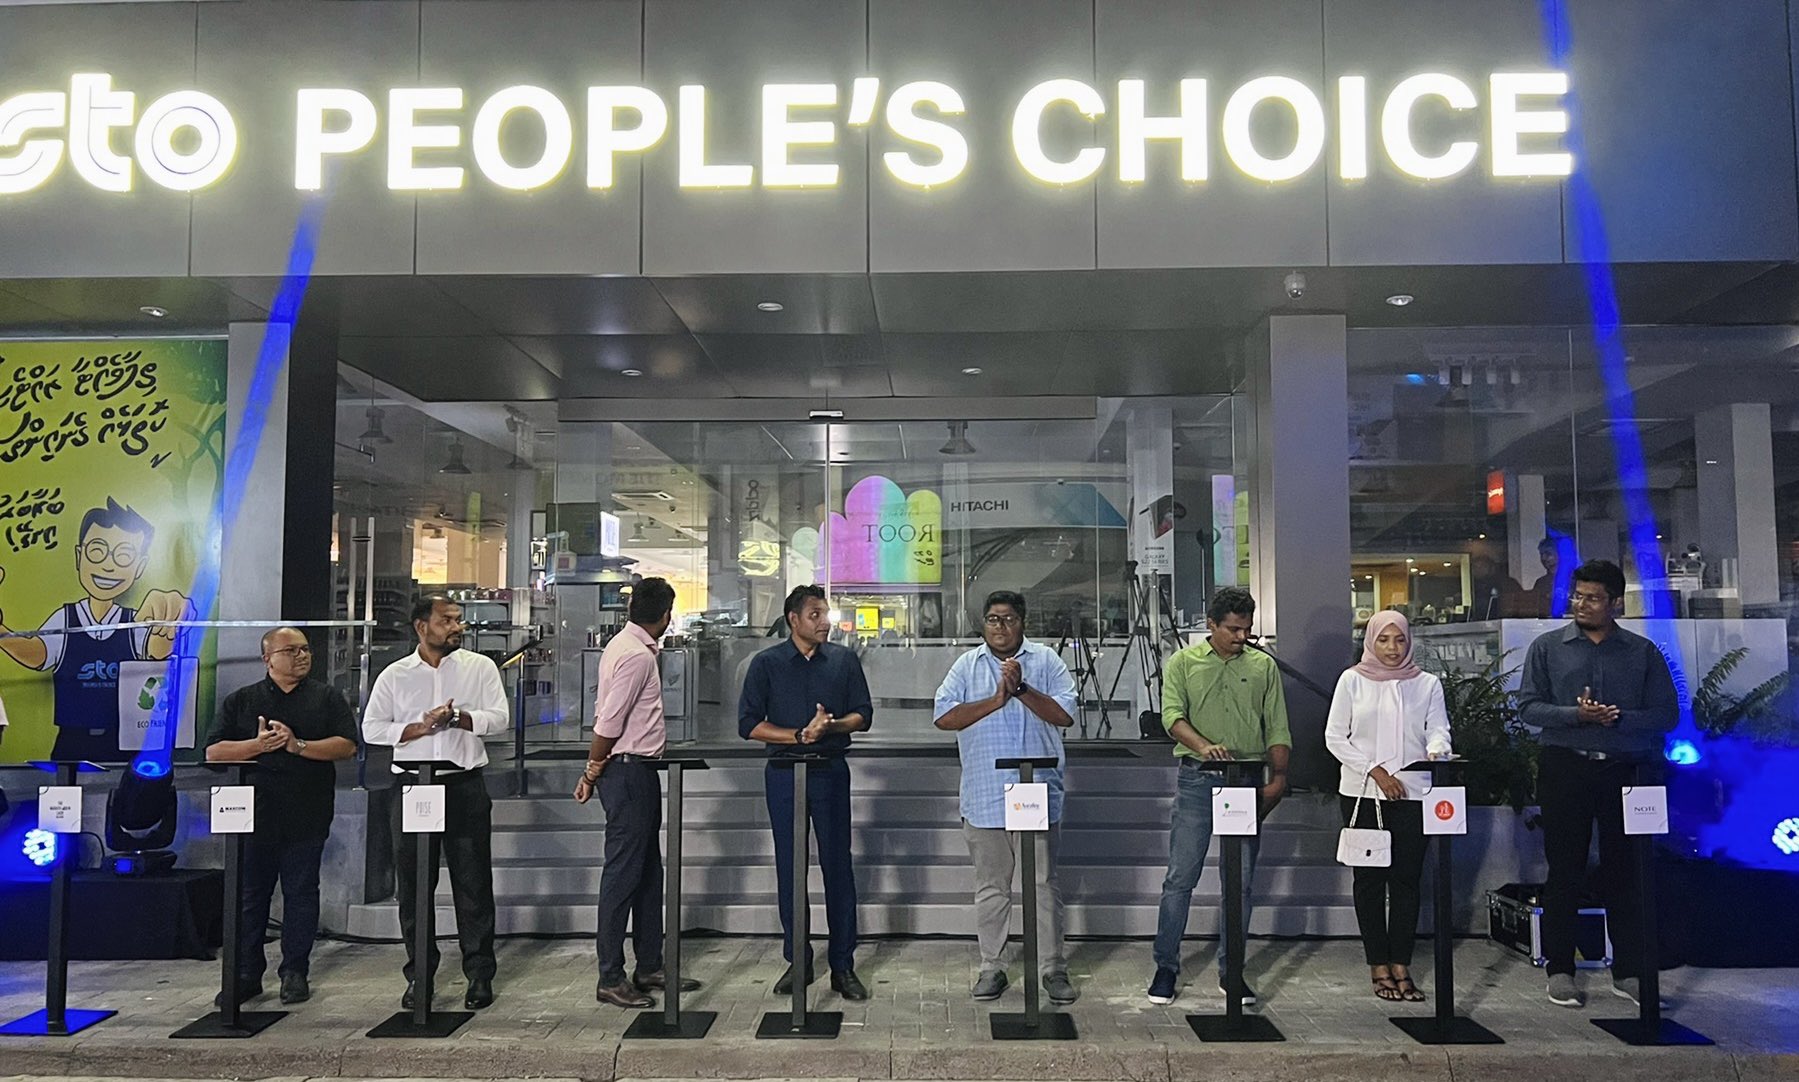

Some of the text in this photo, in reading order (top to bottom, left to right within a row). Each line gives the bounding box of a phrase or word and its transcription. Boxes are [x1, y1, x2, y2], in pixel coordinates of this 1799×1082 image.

[295, 77, 969, 191] PEOPLE'S
[1011, 72, 1575, 185] CHOICE
[950, 500, 1009, 512] HITACHI
[137, 720, 149, 729] ECO
